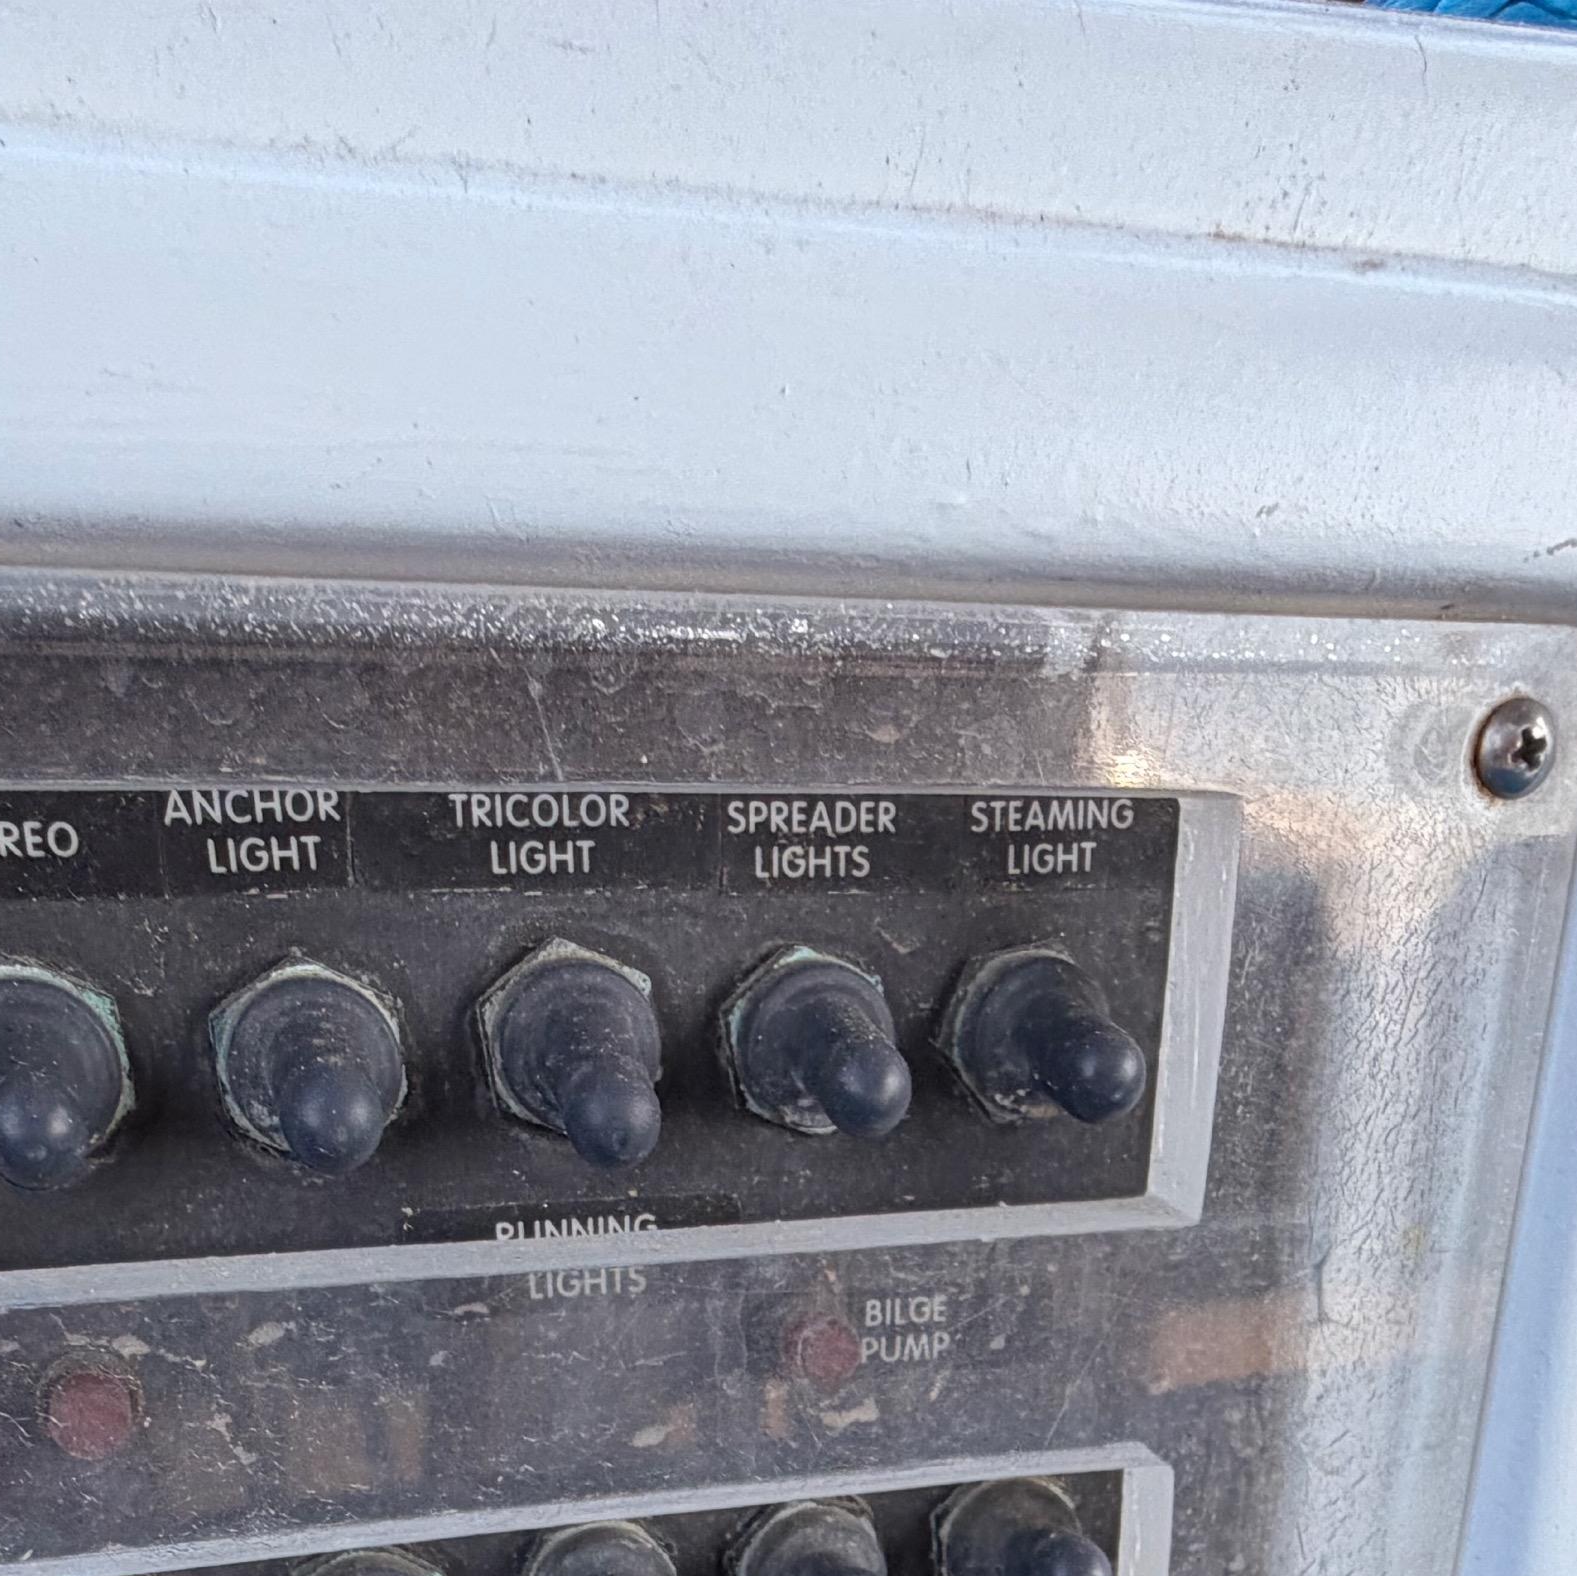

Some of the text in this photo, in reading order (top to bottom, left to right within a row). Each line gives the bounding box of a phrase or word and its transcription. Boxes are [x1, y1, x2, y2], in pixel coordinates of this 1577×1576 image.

[164, 789, 342, 827] ANCHOR
[447, 792, 631, 829] TRICOLOR
[727, 800, 897, 836] SPREADER
[970, 799, 1135, 833] STEAMING
[206, 835, 322, 875] LIGHT
[489, 839, 596, 876] LIGHT
[753, 845, 871, 880] LIGHTS
[1006, 841, 1097, 876] LIGHT
[528, 1265, 648, 1300] LIGHTS
[864, 1295, 948, 1328] BILGE
[859, 1331, 952, 1364] PUMP
